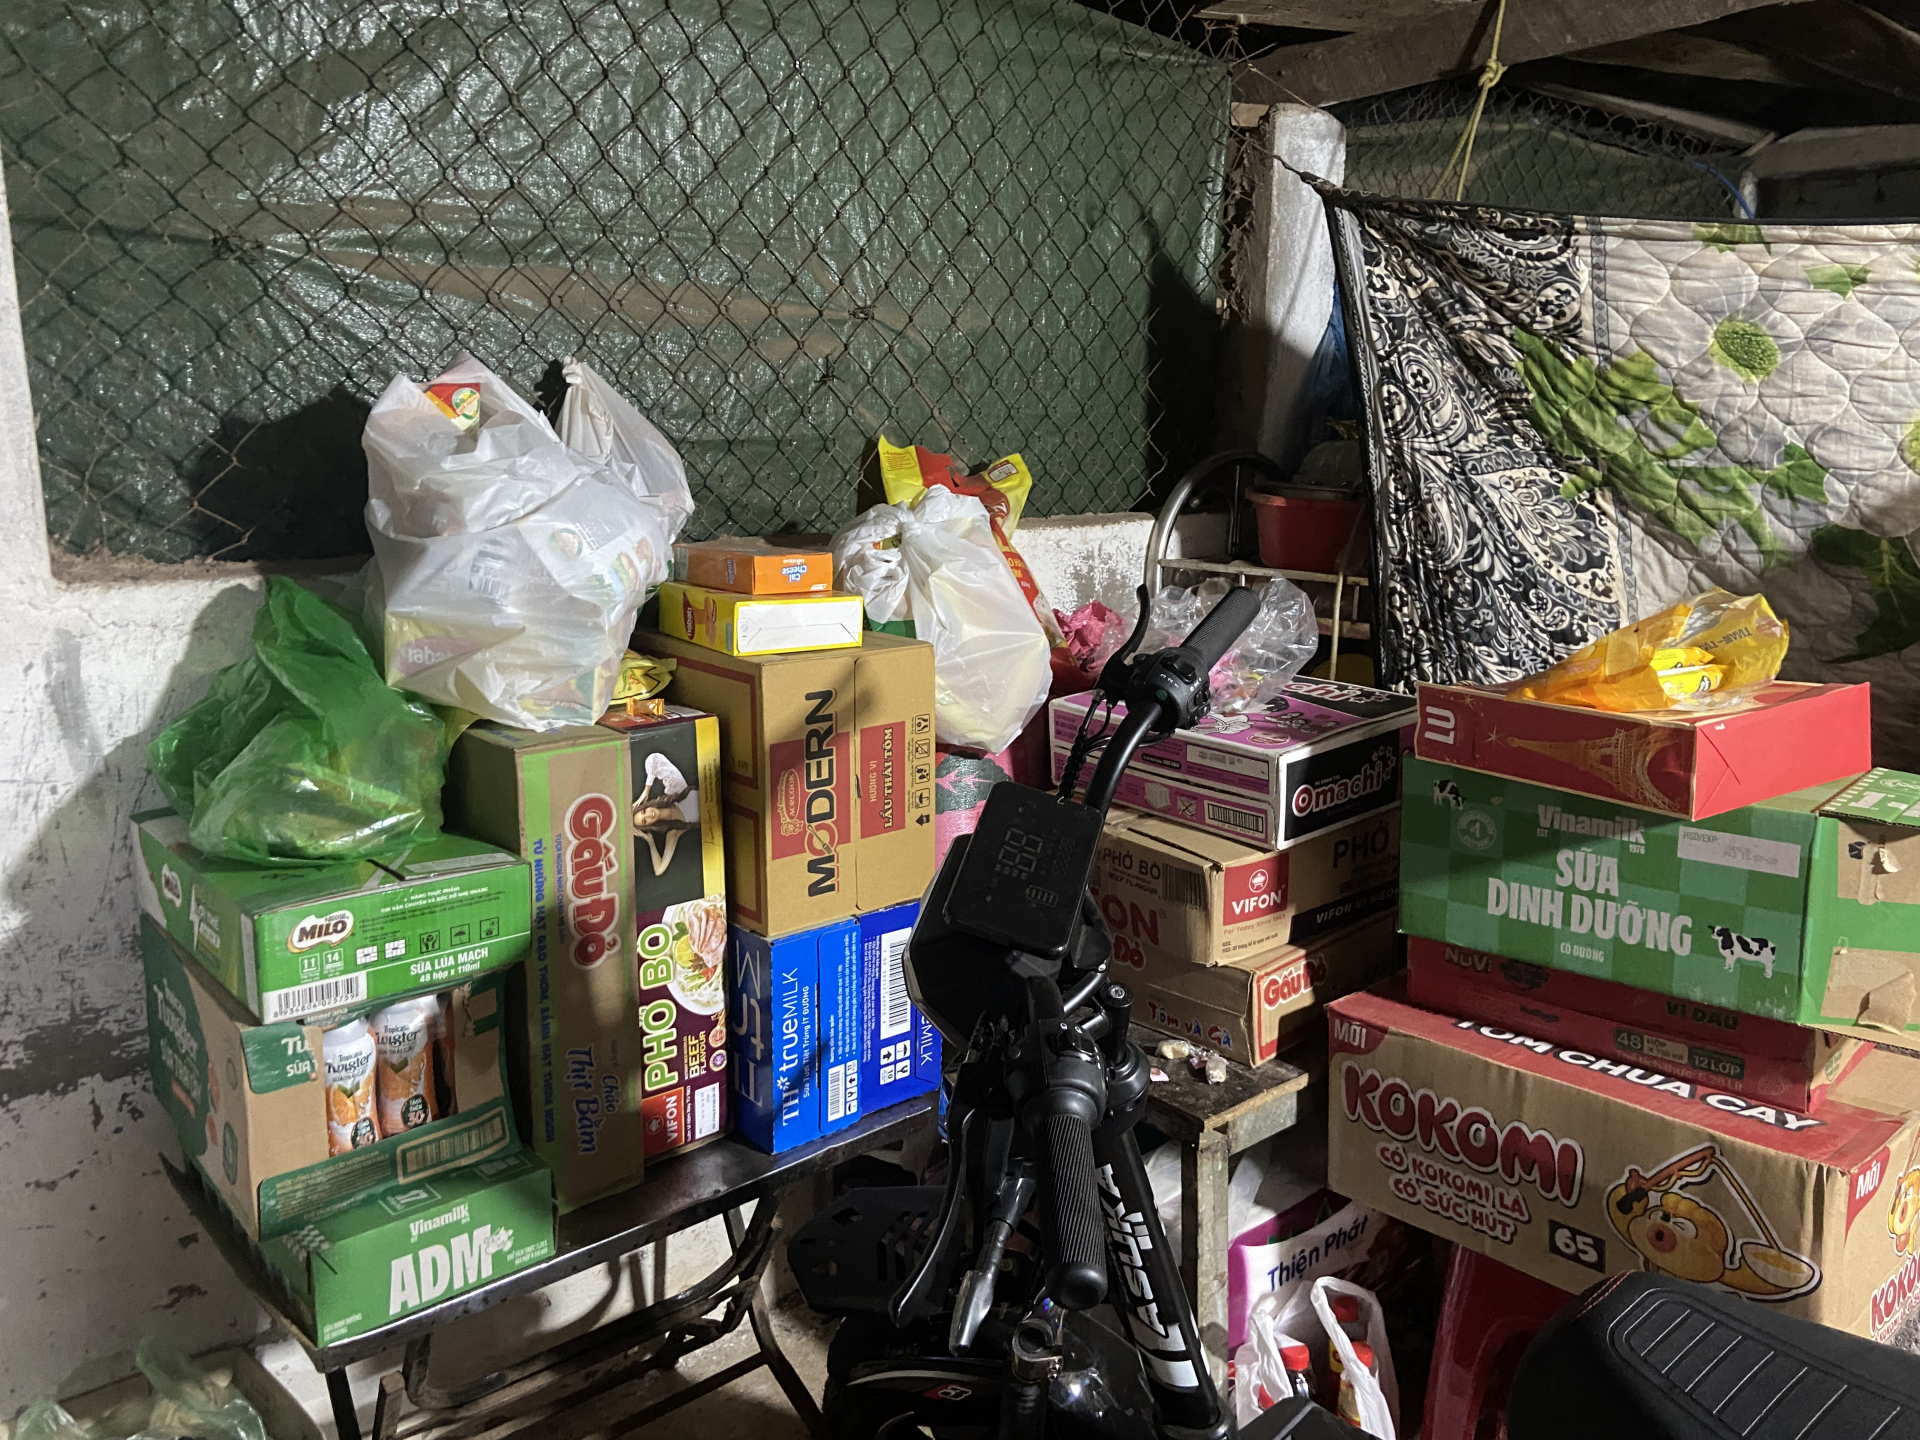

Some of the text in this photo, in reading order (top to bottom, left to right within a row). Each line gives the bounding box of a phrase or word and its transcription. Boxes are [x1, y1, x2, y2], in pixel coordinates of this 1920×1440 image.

[782, 565, 807, 575] Cheese
[789, 574, 801, 583] Cal
[685, 606, 693, 637] nabati
[1424, 706, 1456, 745] LU
[870, 760, 878, 770] VỊ
[879, 727, 893, 829] LẨU THÁI TÔM
[805, 688, 839, 897] MODERN
[1293, 761, 1383, 817] Omachi
[1537, 804, 1645, 845] Vinamilk
[1103, 848, 1133, 870] PHỞ
[1139, 861, 1161, 880] BÒ
[1629, 843, 1645, 854] 1976
[535, 858, 546, 902] NHỮNG
[1556, 847, 1619, 897] SỮA
[534, 905, 547, 930] HẠT
[1232, 890, 1282, 915] VIFON
[1487, 877, 1692, 956] DINH DƯỠNG
[298, 920, 347, 942] MILO
[1237, 924, 1255, 932] Today
[326, 951, 339, 963] 14
[410, 946, 489, 976] SỮA LÚA MẠCH
[419, 974, 431, 983] 48
[433, 970, 448, 981] hộp
[457, 961, 480, 974] 110ml
[1444, 947, 1493, 973] NuVi
[638, 924, 678, 1092] PHỞ BÒ
[801, 986, 810, 1014] ĐƯỜNG
[1263, 968, 1301, 1011] Gấu
[802, 1025, 811, 1048] Trùng
[1148, 1001, 1233, 1049] Tôm và Gà
[1334, 1019, 1367, 1049] MỚI
[1617, 1032, 1642, 1049] 48
[286, 1060, 311, 1078] SỮA
[326, 1051, 373, 1074] Twister
[688, 1034, 701, 1079] BEEF
[699, 1030, 707, 1075] FLAVOUR
[1693, 1055, 1741, 1076] 12 LỚP
[566, 1044, 604, 1153] Thịt Bằm
[602, 1074, 619, 1113] Cháo
[782, 1088, 799, 1127] TH
[802, 1082, 810, 1098] Sữa
[1558, 1048, 1827, 1131] CHUA CAY
[666, 1095, 678, 1143] VIFON
[1342, 1061, 1584, 1207] KOKOMI
[1379, 1144, 1525, 1218] CÓ KOKOMI LÀ
[1856, 1159, 1882, 1200] MỚI
[410, 1202, 469, 1237] Vinamilk
[1393, 1175, 1513, 1239] CÓ SỨC HÚT
[1098, 1163, 1170, 1339] ASUKA
[1267, 1214, 1369, 1292] Thiện Phát
[1555, 1227, 1598, 1263] 65
[389, 1224, 493, 1316] ADM
